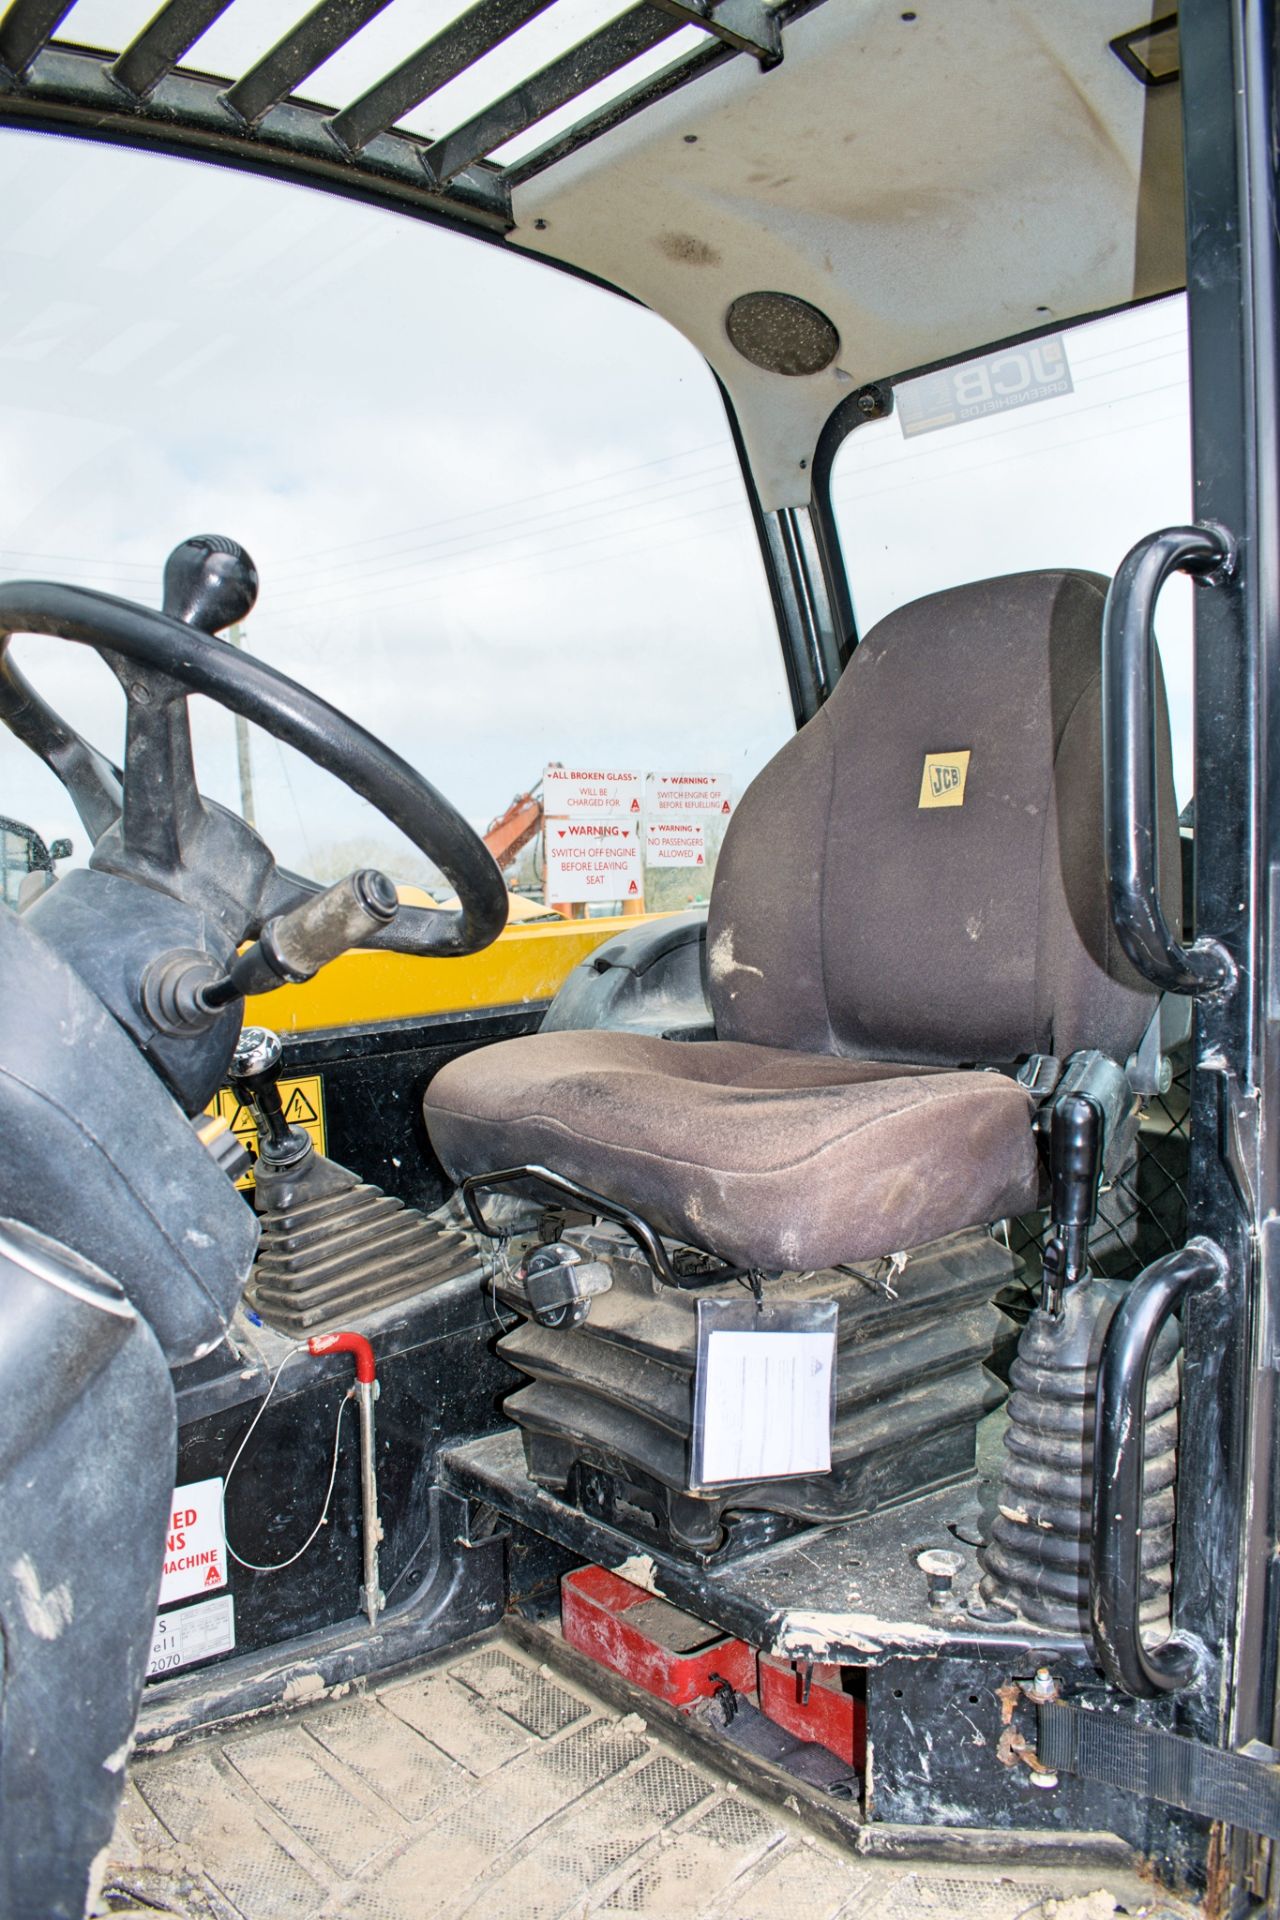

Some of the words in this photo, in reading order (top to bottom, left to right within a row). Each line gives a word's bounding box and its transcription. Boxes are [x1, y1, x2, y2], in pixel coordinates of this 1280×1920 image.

[552, 771, 569, 780] ALL
[570, 772, 605, 781] BROKEN
[606, 773, 632, 781] GLASS
[933, 767, 959, 794] JCB
[670, 777, 708, 785] WARNING
[579, 788, 598, 796] WILL
[599, 788, 608, 796] BE
[657, 791, 684, 799] SWITCH
[684, 791, 708, 799] ENGINE
[709, 791, 721, 799] OFF
[567, 798, 604, 807] CHARGED
[605, 798, 621, 807] FOR
[659, 801, 683, 809] BEFORE
[685, 801, 720, 809] REFUELLING
[568, 825, 619, 836] WARNING
[658, 824, 693, 833] WARNING
[647, 838, 660, 846] NO
[662, 838, 704, 847] PASSENGERS
[551, 848, 586, 858] SWITCH
[588, 848, 605, 857] OFF
[605, 847, 637, 857] ENGINE
[658, 849, 694, 858] ALLOWED
[561, 861, 593, 872] BEFORE
[594, 861, 628, 871] LEAVING
[586, 875, 605, 885] SEAT
[169, 1509, 198, 1531] ED
[150, 1653, 181, 1673] 2070
